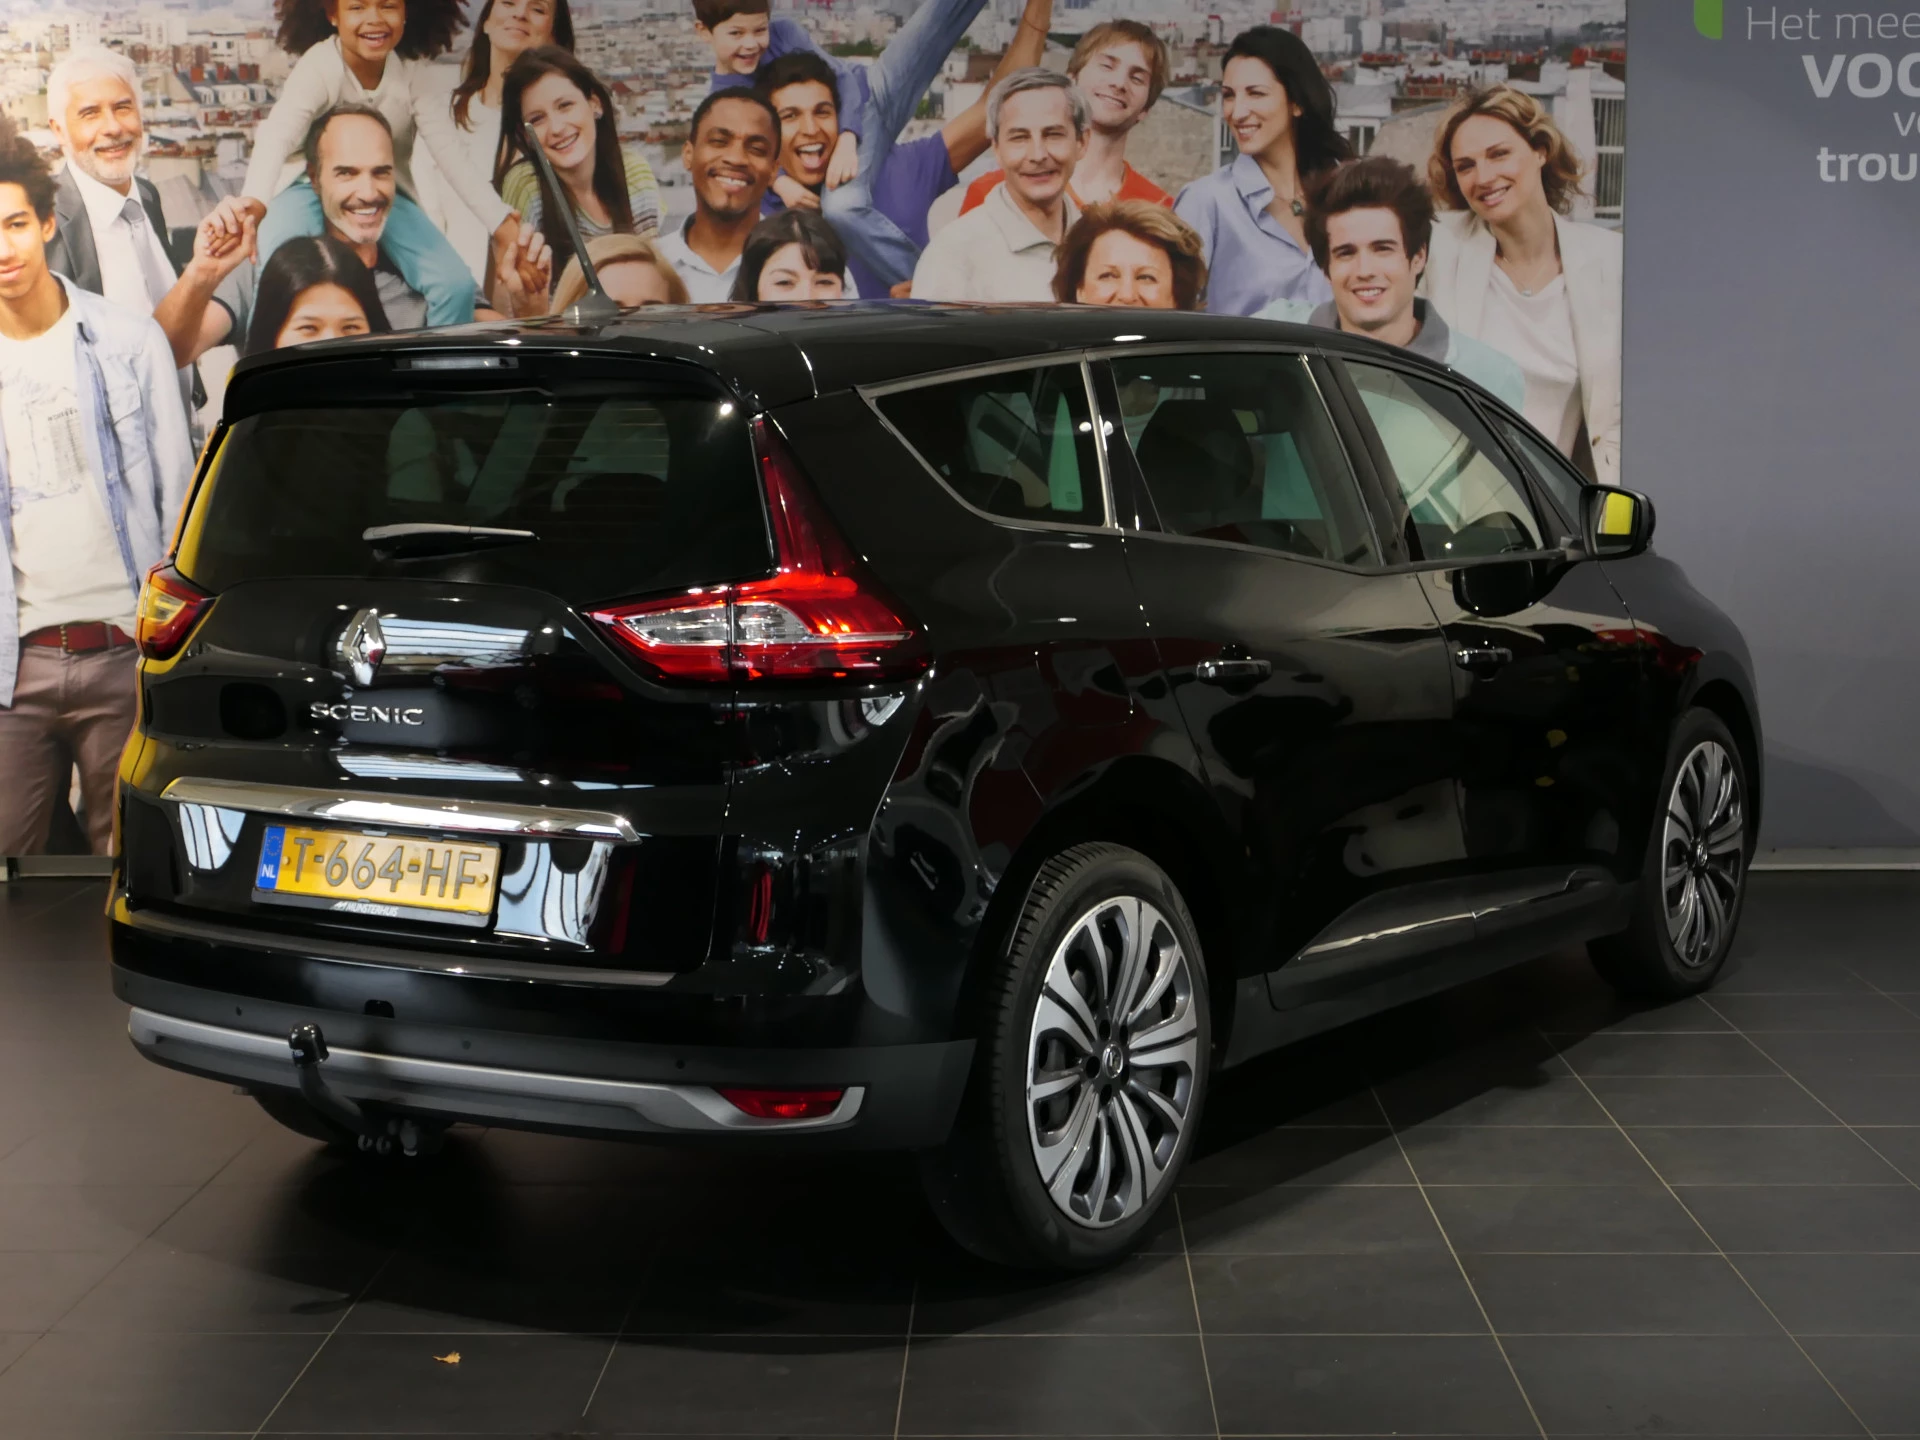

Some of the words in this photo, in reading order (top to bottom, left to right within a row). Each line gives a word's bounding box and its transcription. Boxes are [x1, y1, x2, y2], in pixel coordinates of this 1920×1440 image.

[1747, 6, 1821, 40] Het
[1893, 112, 1920, 137] v
[1816, 147, 1918, 182] trou
[310, 702, 424, 725] SCENIC
[261, 863, 276, 879] NL
[294, 837, 481, 899] T-664-HF
